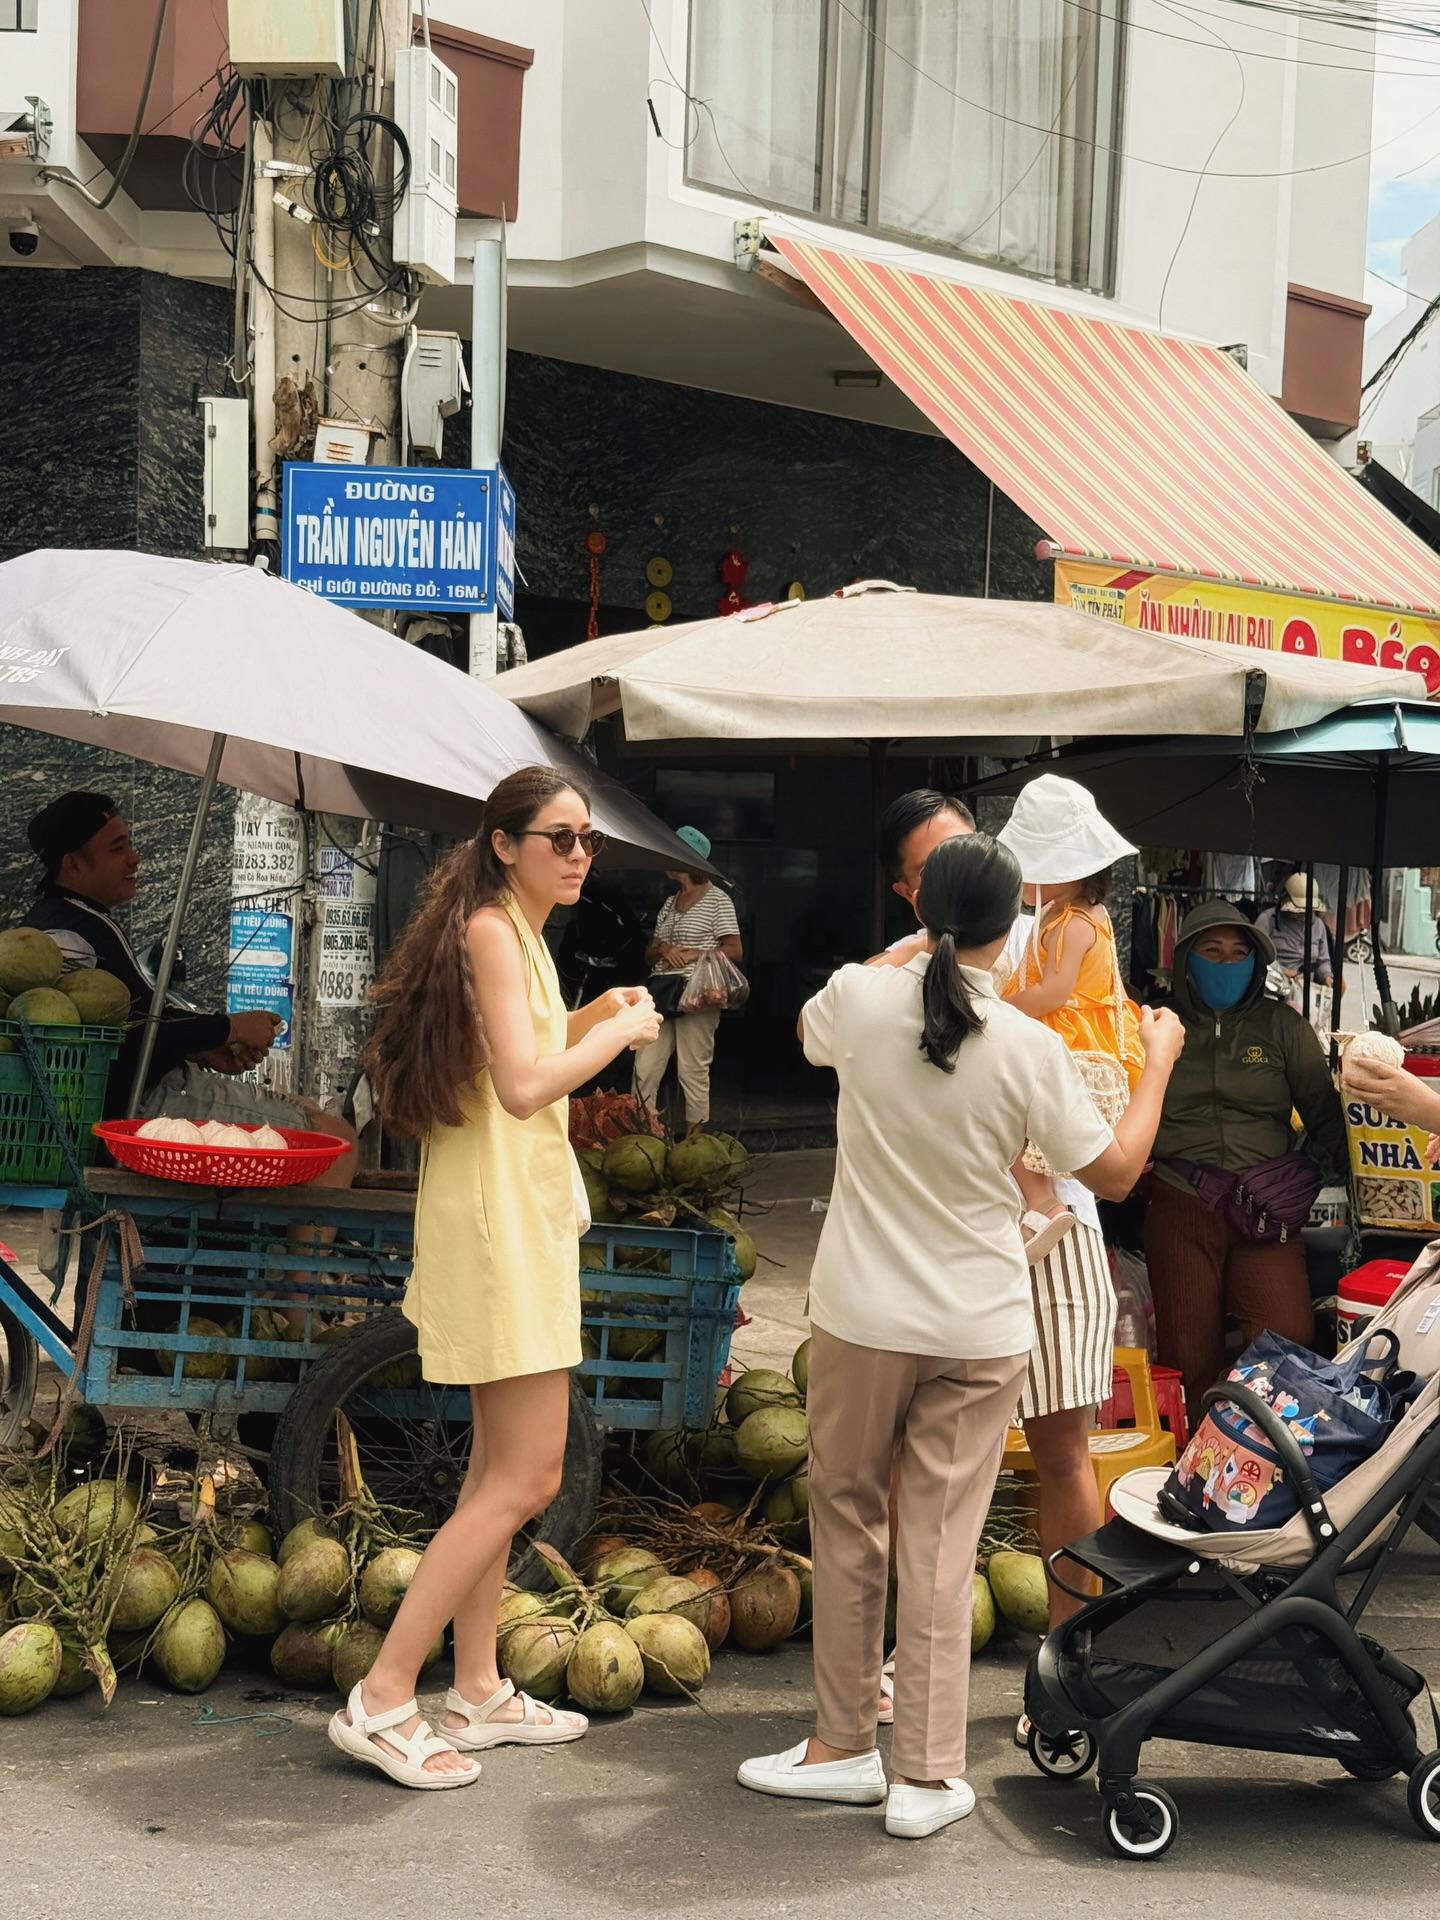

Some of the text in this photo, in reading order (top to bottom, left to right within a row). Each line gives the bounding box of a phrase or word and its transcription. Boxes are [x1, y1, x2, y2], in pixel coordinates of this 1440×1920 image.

[344, 479, 435, 503] ĐƯỜNG
[296, 498, 349, 566] TRẦN
[354, 508, 435, 569] NGUYÊN
[439, 511, 482, 571] HÃN
[326, 578, 357, 595] GIỚI
[360, 578, 412, 597] ĐƯỜNG
[447, 585, 479, 599] 16M
[1102, 600, 1124, 620] PHÁT
[1358, 1137, 1423, 1171] NHÀ
